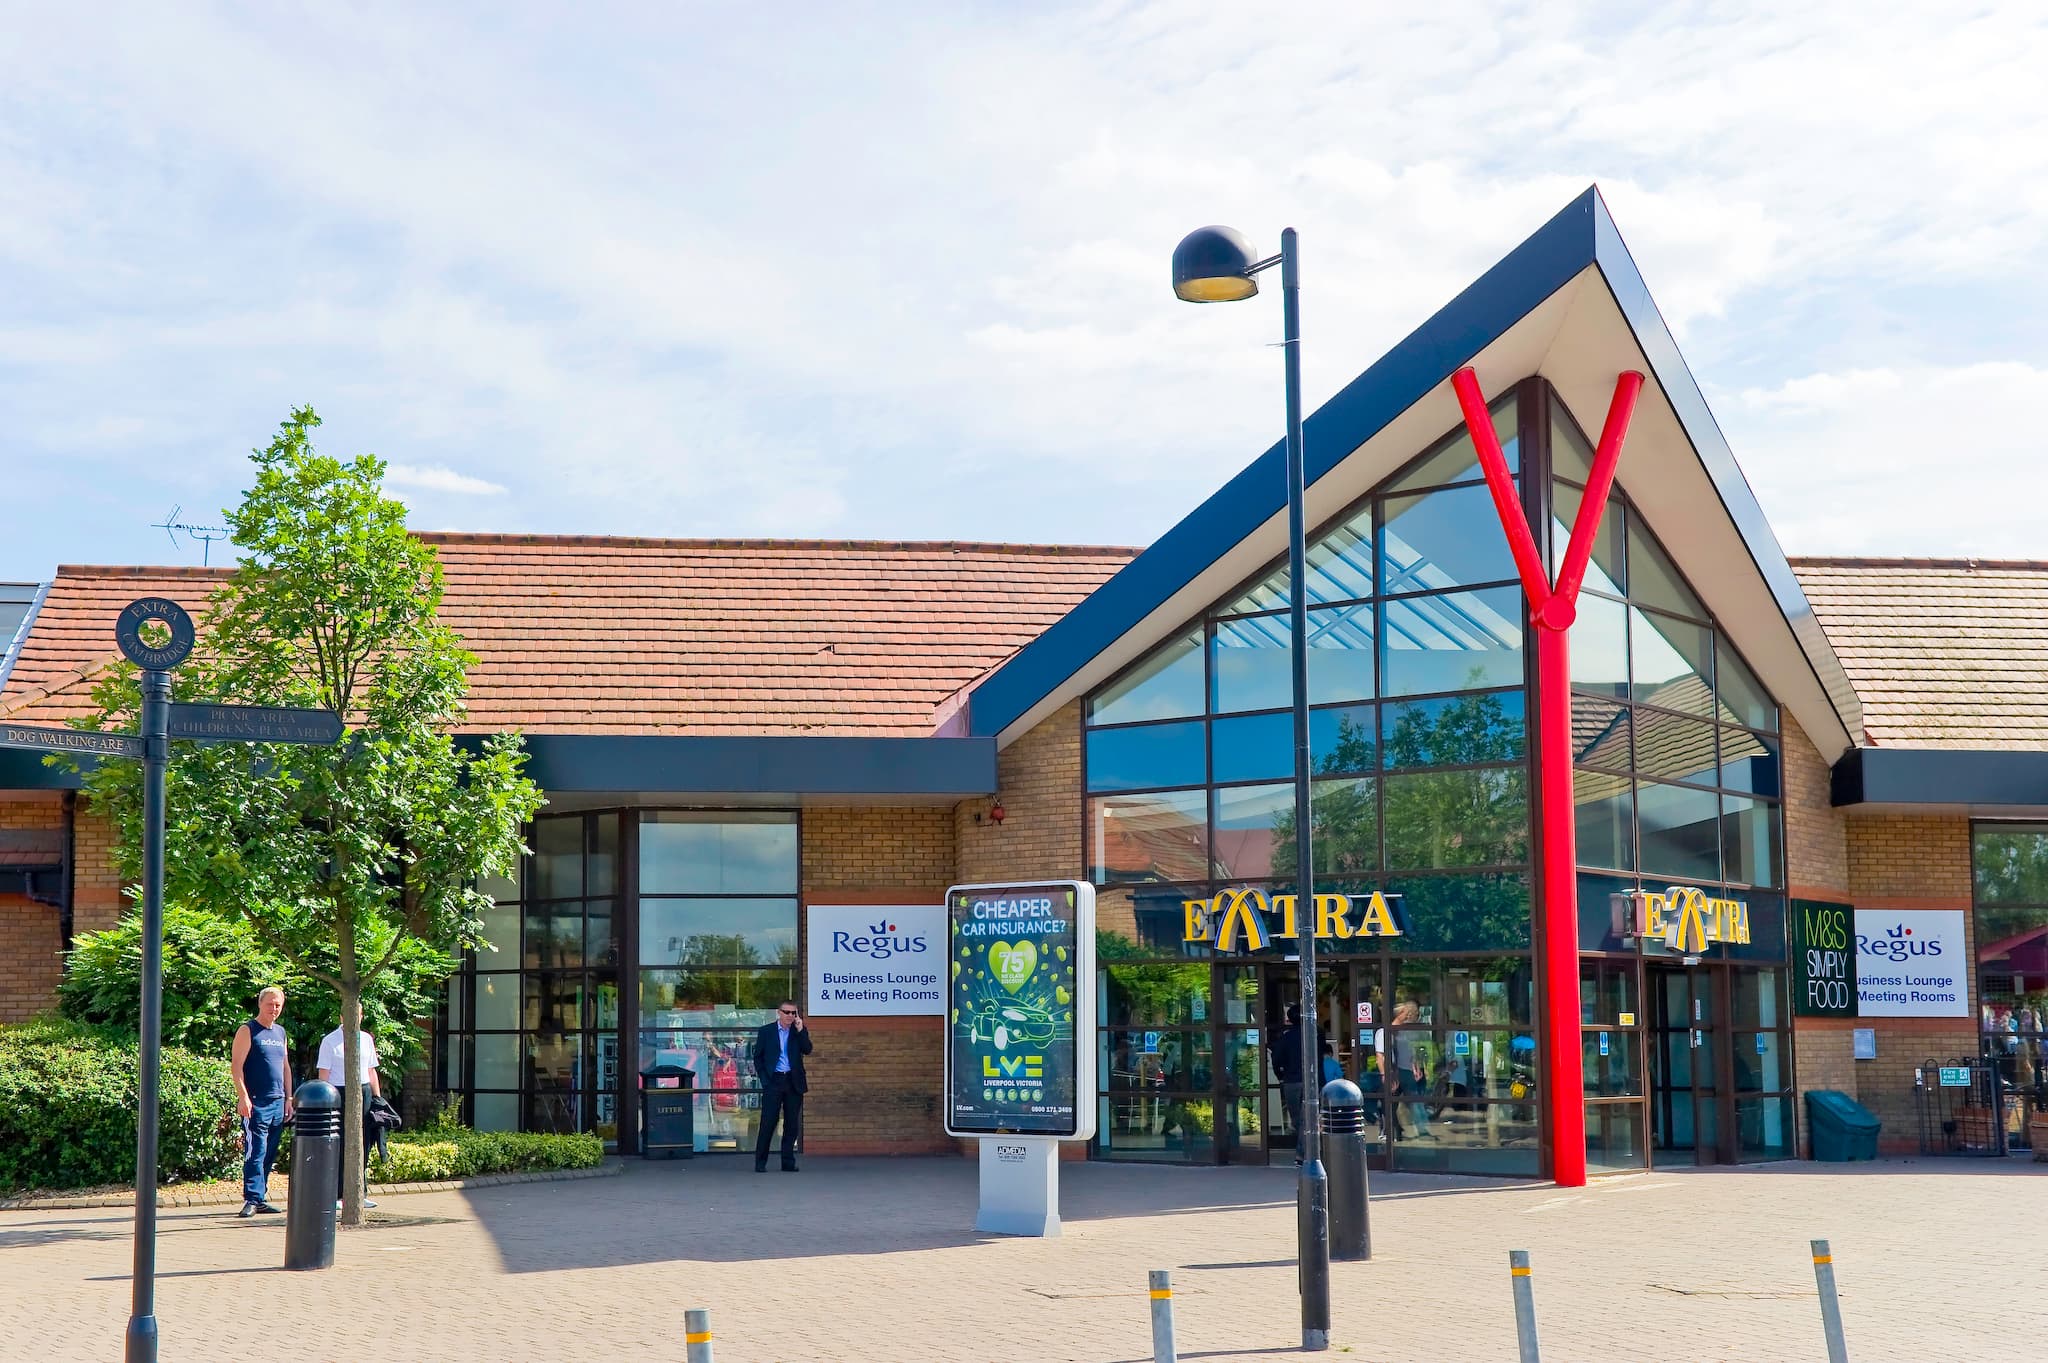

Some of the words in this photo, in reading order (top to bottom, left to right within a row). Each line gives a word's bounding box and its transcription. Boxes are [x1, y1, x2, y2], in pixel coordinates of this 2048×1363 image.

[131, 602, 178, 620] EXTRA
[123, 633, 188, 663] CAMBRIDGE
[210, 710, 250, 721] PICNIC
[258, 712, 296, 724] AREA
[8, 729, 36, 743] DOG
[39, 732, 97, 748] WALKING
[100, 738, 132, 751] AREA
[259, 725, 289, 737] PLAY
[295, 726, 332, 739] AREA
[973, 898, 1052, 920] CHEAPER
[1181, 885, 1404, 952] EXTRA
[1640, 886, 1751, 952] EXTRA
[962, 922, 986, 937] CAR
[988, 919, 1066, 936] INSURANCE?
[1805, 908, 1847, 950] M&S
[832, 931, 927, 960] Regus
[1855, 934, 1942, 962] Regus
[998, 951, 1025, 973] 75
[1806, 949, 1848, 979] SIMPLY
[823, 972, 883, 984] Business
[887, 972, 937, 986] Lounge
[1905, 974, 1953, 989] Lounge
[820, 989, 831, 1001] &
[835, 989, 888, 1003] Meeting
[892, 989, 939, 1001] Rooms
[1807, 980, 1849, 1009] FOOD
[1857, 990, 1907, 1004] Meeting
[1911, 991, 1956, 1002] Rooms
[983, 1079, 1016, 1087] LIVERPOOL
[1016, 1079, 1043, 1088] VICTORIA
